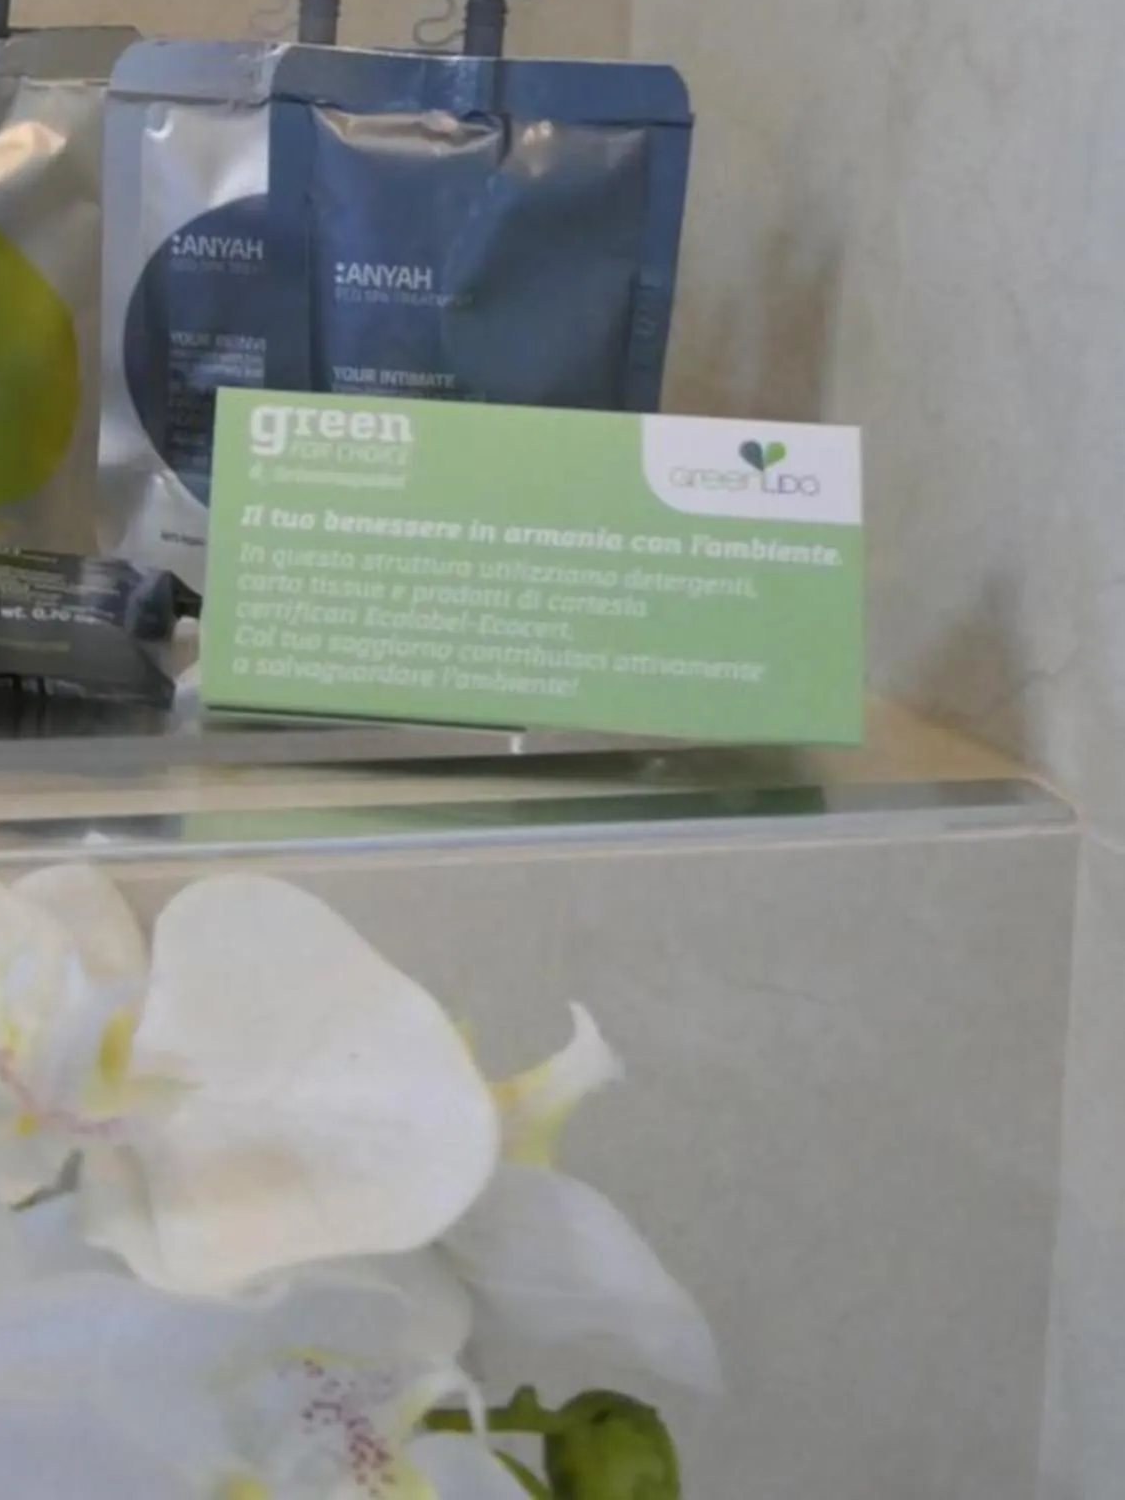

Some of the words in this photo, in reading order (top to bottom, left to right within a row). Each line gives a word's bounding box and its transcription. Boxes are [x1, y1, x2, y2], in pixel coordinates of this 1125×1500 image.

[248, 405, 415, 458] green
[271, 507, 316, 532] tuo
[324, 508, 463, 539] benessere
[468, 518, 497, 543] in
[504, 526, 624, 552] armonia
[630, 534, 683, 555] con
